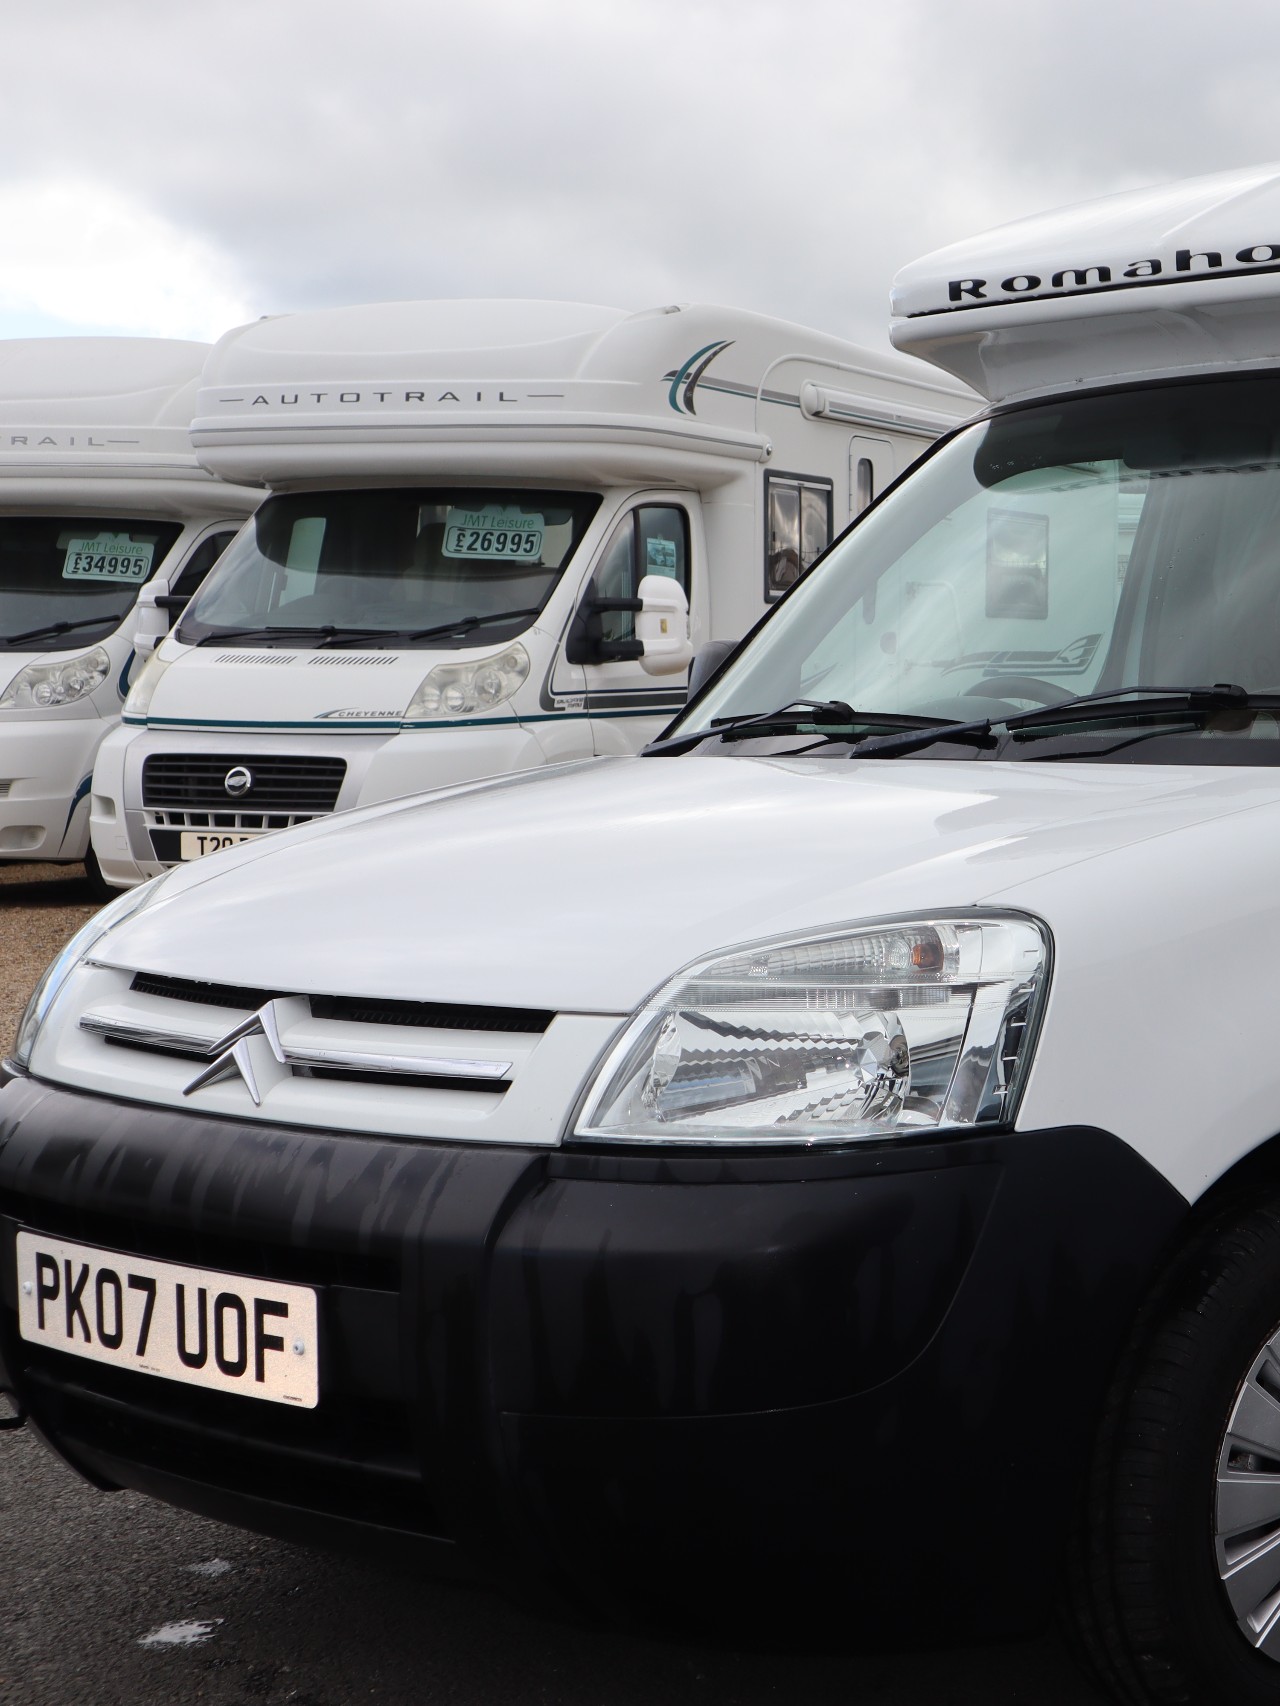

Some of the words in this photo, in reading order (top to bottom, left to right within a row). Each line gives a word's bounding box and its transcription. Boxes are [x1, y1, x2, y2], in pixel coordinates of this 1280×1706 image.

[251, 391, 518, 406] AUTOTRAIL
[0, 436, 105, 446] RAIL
[461, 514, 488, 526] JMT
[491, 516, 535, 529] Leisure
[78, 542, 100, 553] JMT
[103, 543, 143, 555] Leisure
[454, 529, 537, 554] £26995
[71, 553, 144, 576] £34995
[35, 1251, 157, 1357] PK07
[175, 1282, 289, 1383] UOF
